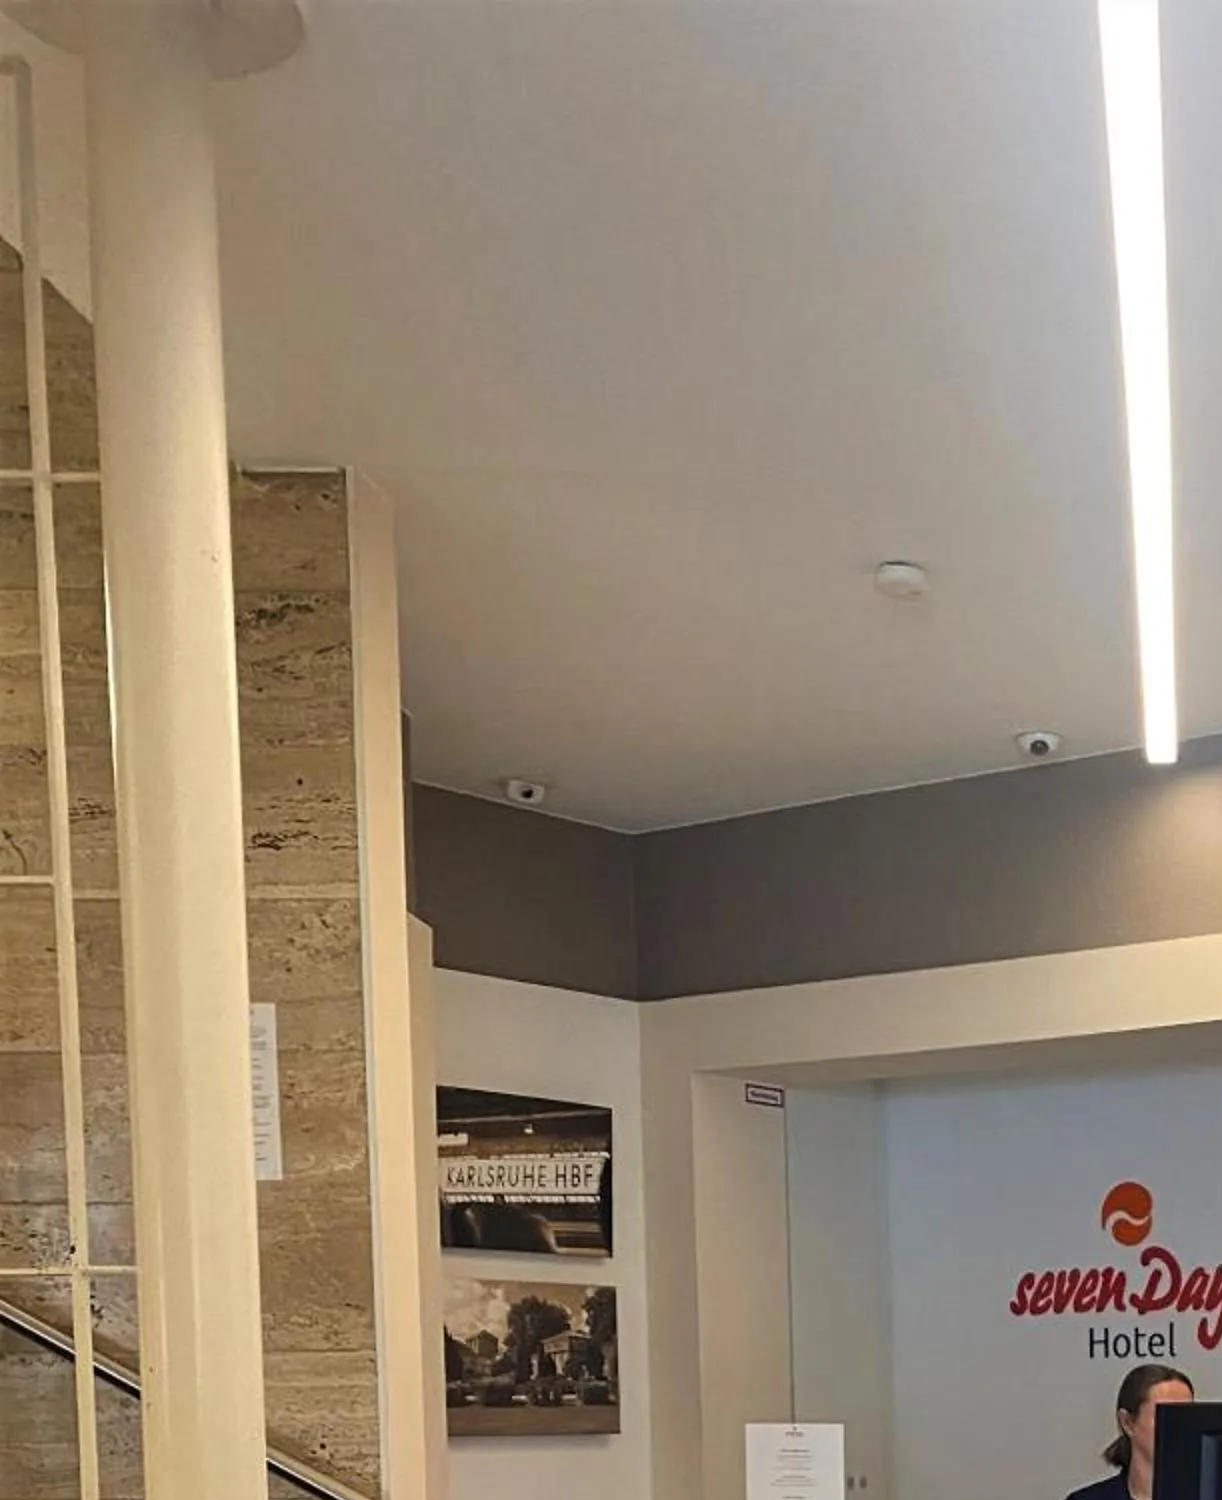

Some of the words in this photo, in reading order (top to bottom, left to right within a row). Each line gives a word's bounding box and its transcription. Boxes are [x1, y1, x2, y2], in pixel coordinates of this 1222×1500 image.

[447, 1164, 547, 1188] KARLSRUHE
[556, 1163, 593, 1188] HBF
[1089, 1322, 1177, 1359] Hotel
